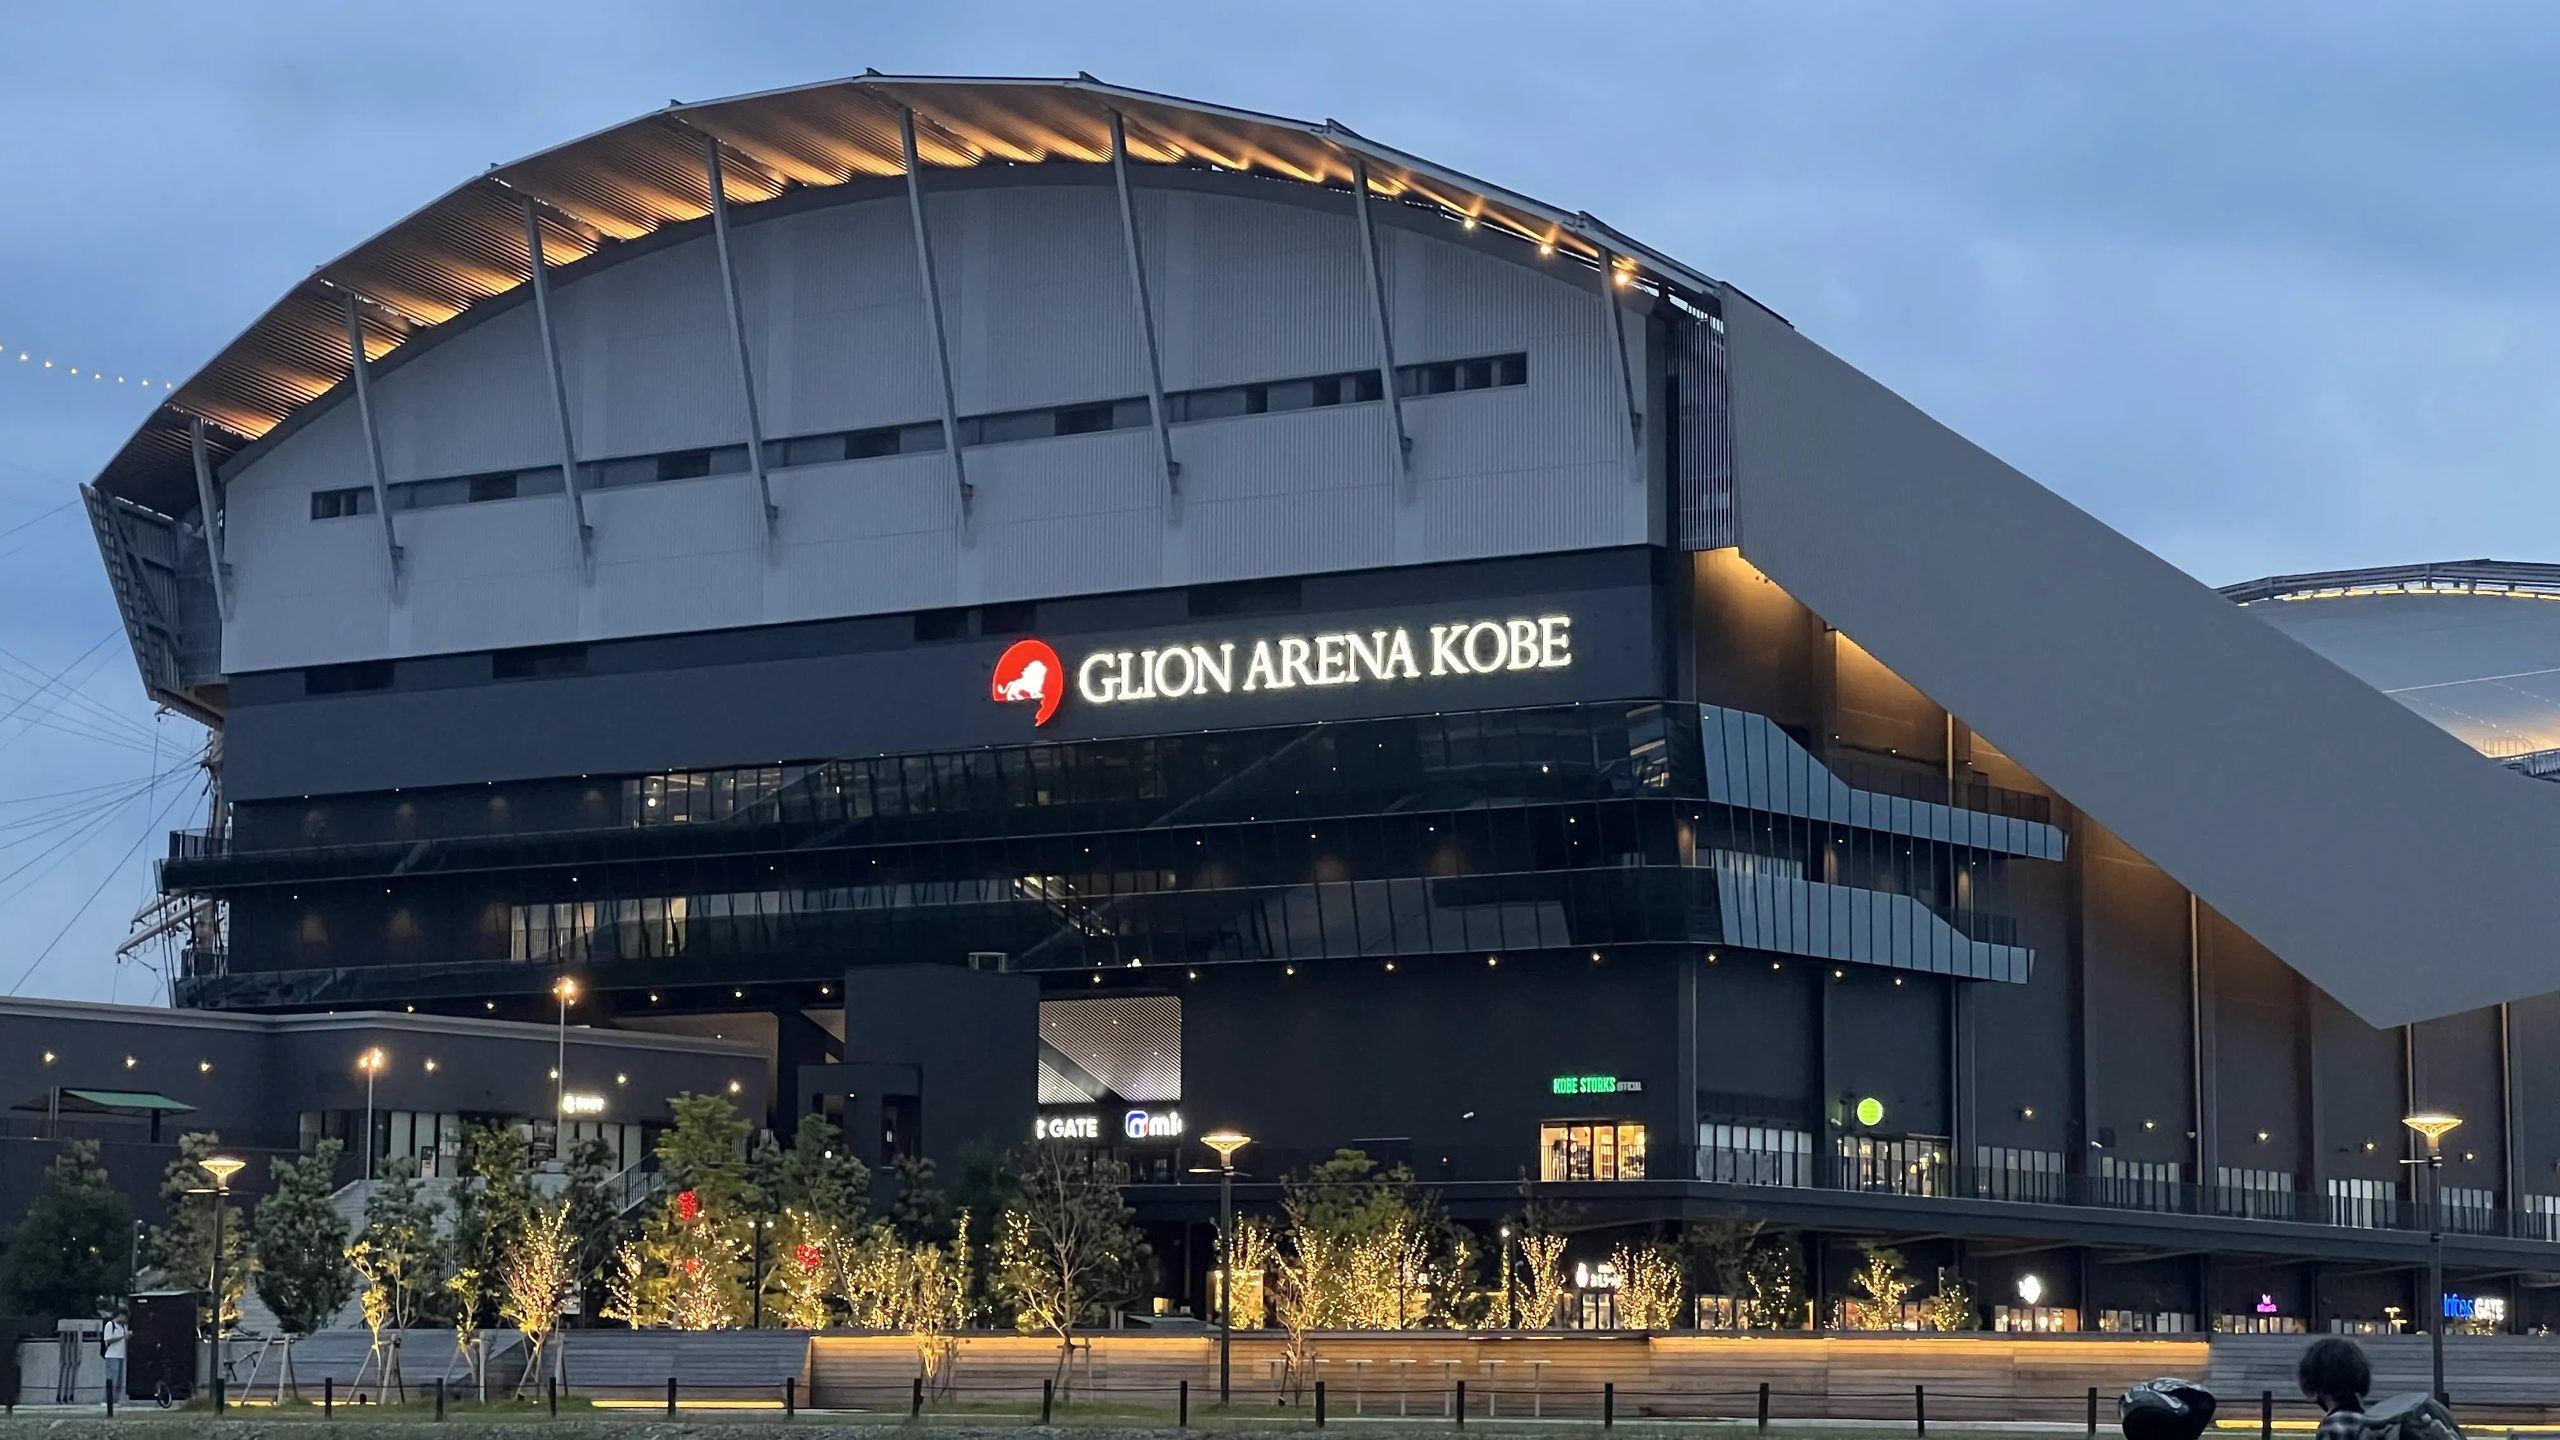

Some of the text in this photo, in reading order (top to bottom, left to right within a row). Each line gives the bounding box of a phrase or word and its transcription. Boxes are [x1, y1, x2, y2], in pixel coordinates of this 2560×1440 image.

[1079, 616, 1574, 703] GLION ARENA KOBE
[1553, 1078, 1578, 1094] KOBE
[1580, 1077, 1616, 1093] STORKS
[1049, 1117, 1098, 1138] GATE
[2474, 1297, 2505, 1321] GATE
